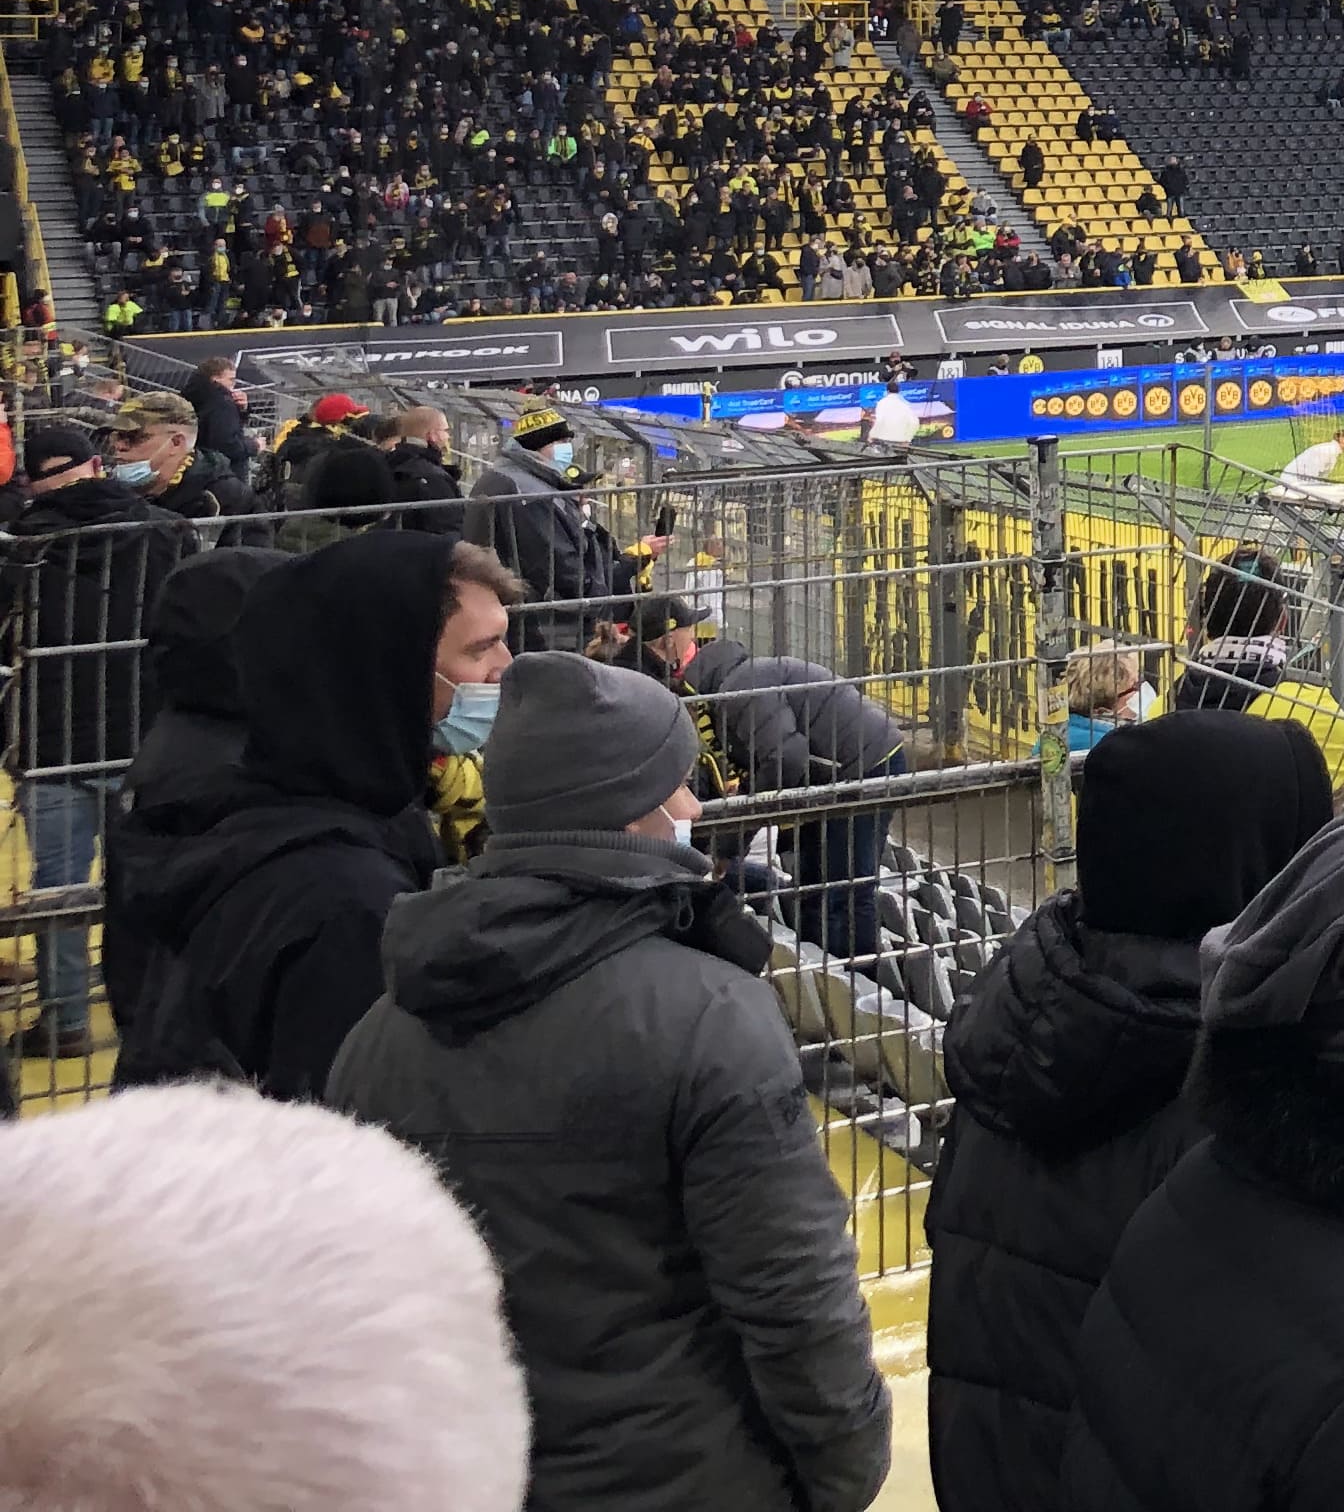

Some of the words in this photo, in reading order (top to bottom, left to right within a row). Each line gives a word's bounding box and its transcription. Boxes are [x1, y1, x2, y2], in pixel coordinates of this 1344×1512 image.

[964, 320, 1058, 332] SIGNAL
[1059, 318, 1137, 330] IDUNA
[670, 327, 838, 352] wilo
[1149, 391, 1169, 406] BVB
[1184, 389, 1204, 405] BVB
[1220, 383, 1238, 400] BVB
[1117, 395, 1135, 407] BVB
